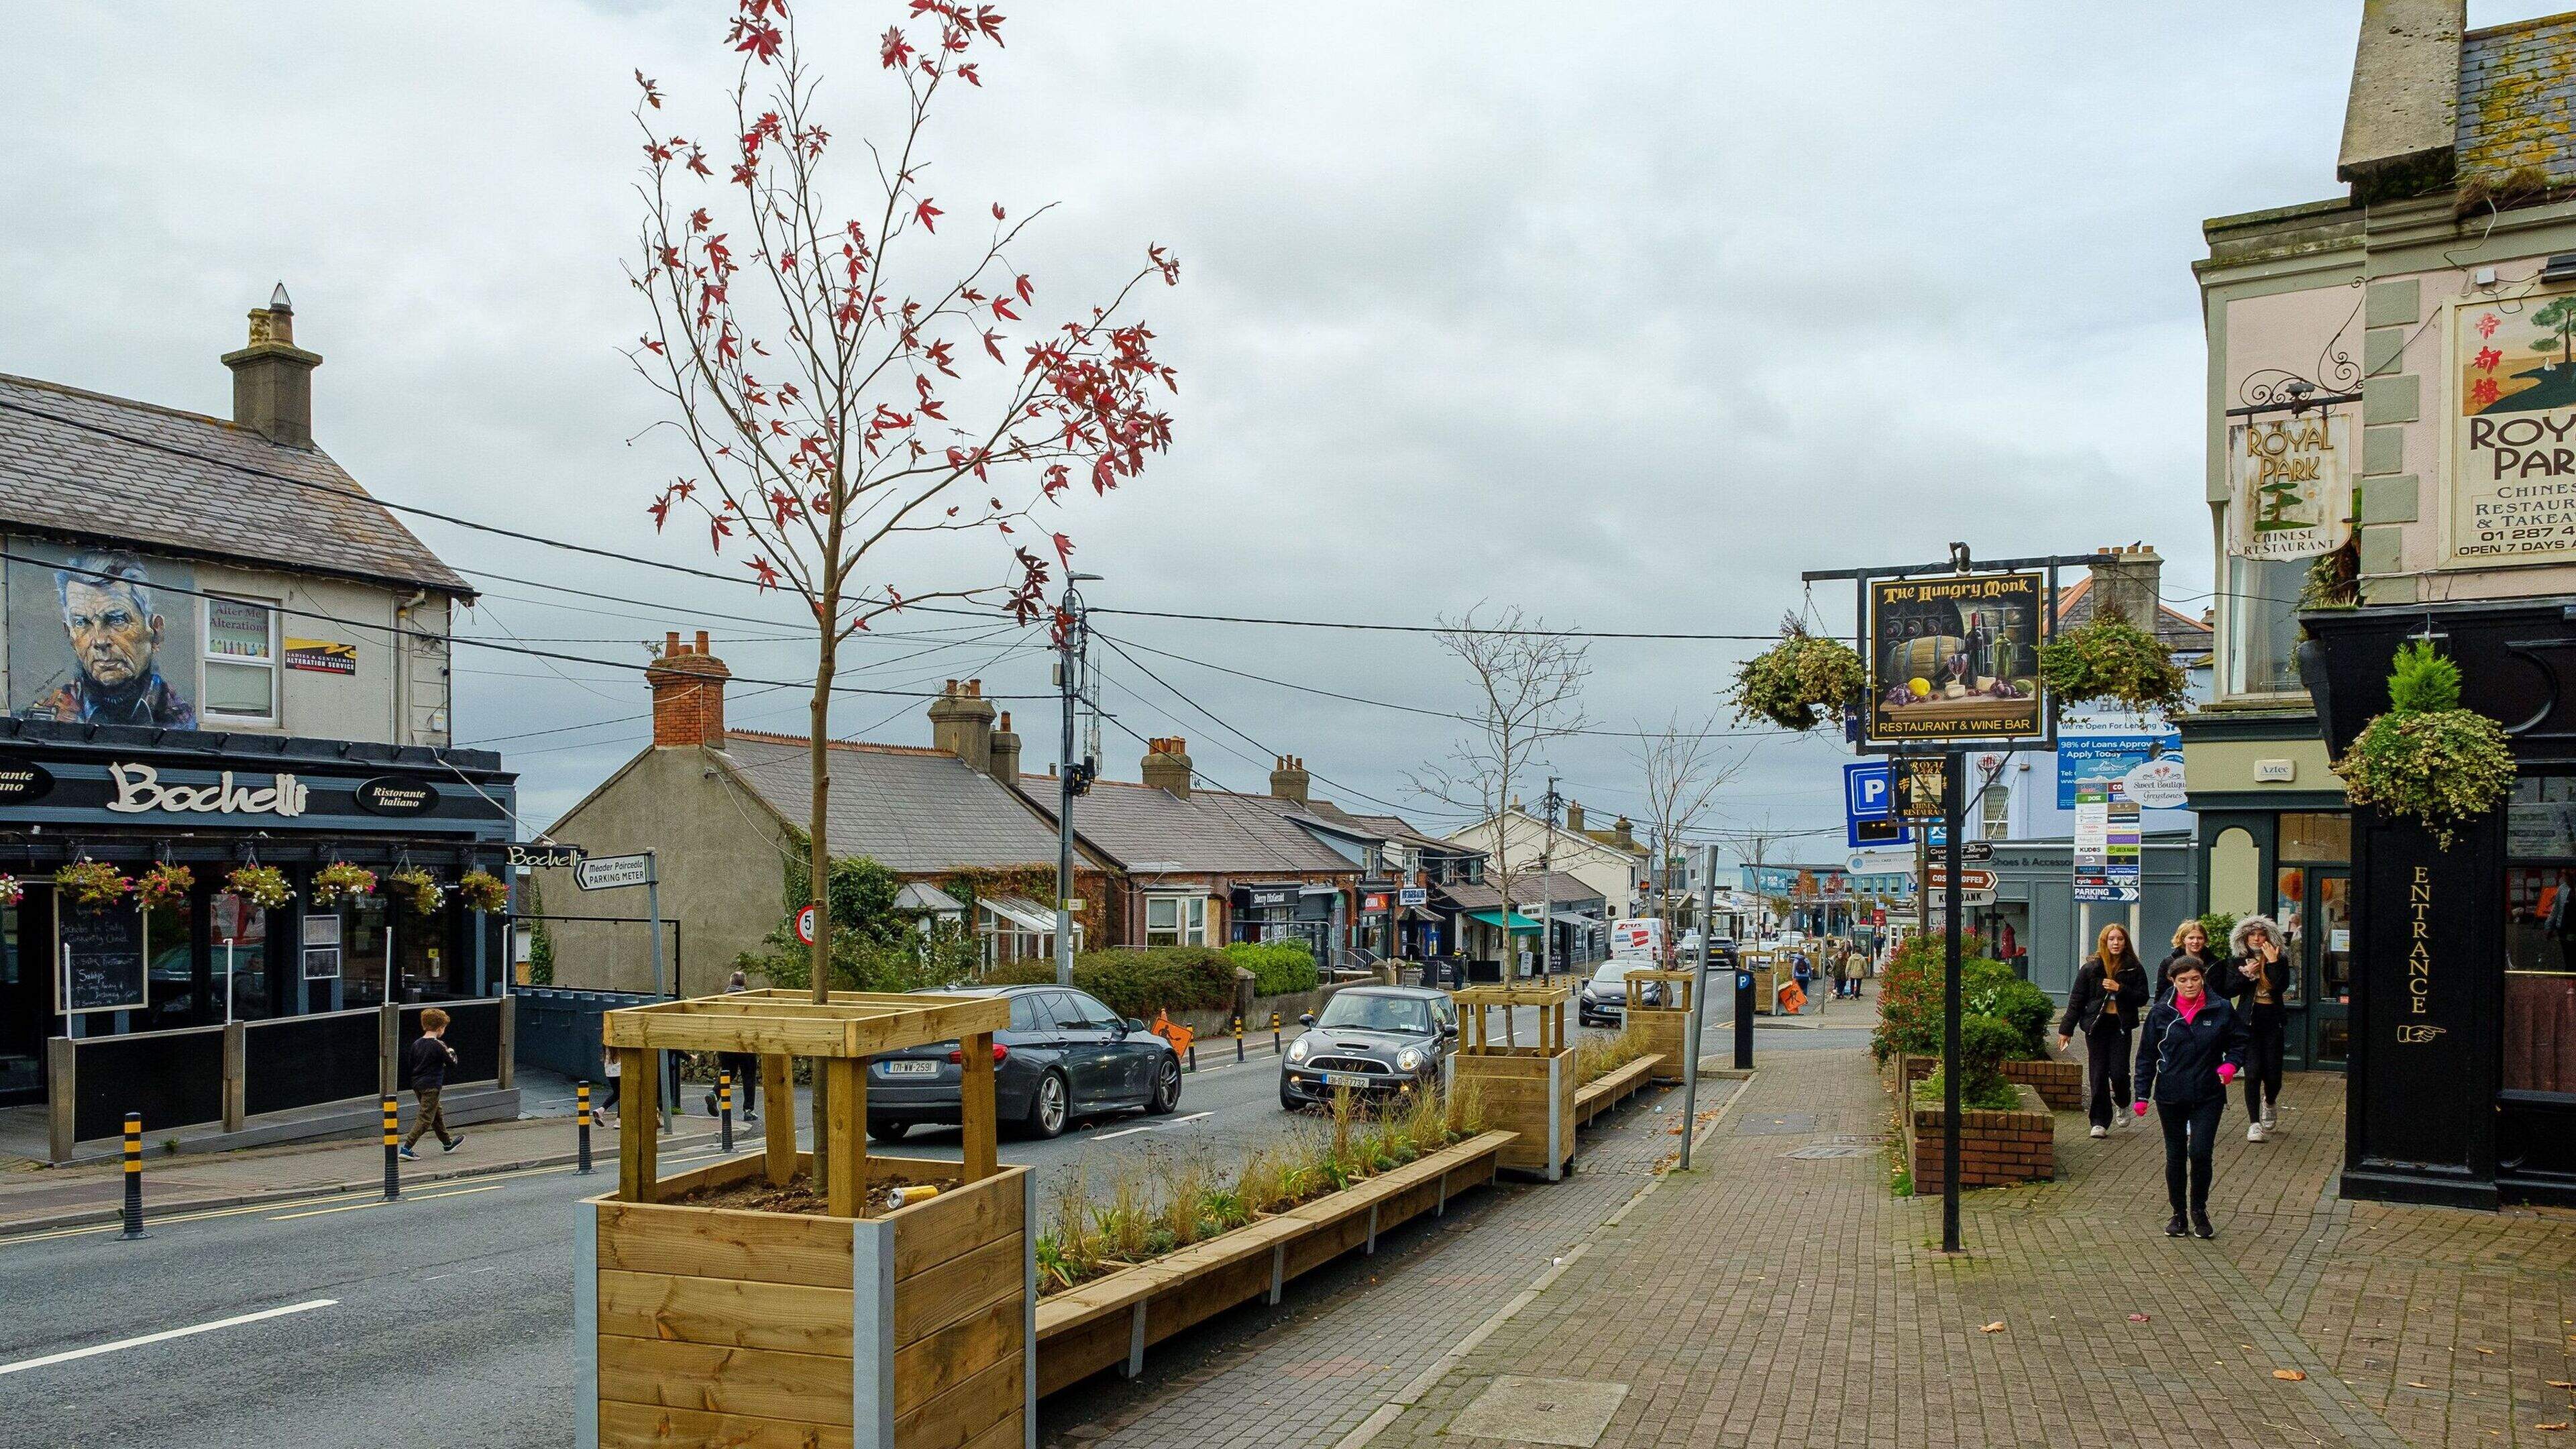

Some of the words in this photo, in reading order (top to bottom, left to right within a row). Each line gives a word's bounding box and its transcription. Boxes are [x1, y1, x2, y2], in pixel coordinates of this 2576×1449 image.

[2471, 414, 2576, 450] ROY
[2247, 427, 2334, 457] ROYAL
[2260, 455, 2320, 484] PARK
[2477, 519, 2492, 529] &
[2501, 513, 2576, 527] TAKEA
[2253, 529, 2315, 543] CHINESE
[2481, 531, 2504, 541] 01
[2512, 527, 2554, 539] 287
[2244, 539, 2334, 555] RESTAURANT
[2459, 545, 2501, 555] OPEN
[2506, 544, 2516, 552] 7
[2522, 540, 2565, 551] DAYS
[1917, 584, 1980, 602] Hungry
[1982, 578, 2033, 599] Monk
[286, 658, 326, 667] ALTERATION
[328, 661, 354, 670] SERVICE
[1879, 721, 1958, 733] RESTAURANT
[1960, 720, 1968, 730] &
[1970, 720, 2004, 731] WINE
[2004, 719, 2031, 730] BAR
[2086, 722, 2106, 731] Open
[2067, 751, 2092, 759] Apply
[0, 771, 34, 781] ante
[2261, 765, 2288, 773] Aztec
[107, 761, 310, 817] Bochelli
[372, 787, 426, 798] Ristorante
[1865, 780, 1885, 803] P
[378, 797, 420, 807] Italiano
[2143, 791, 2182, 802] Greystones
[1992, 857, 2019, 867] Shoes
[2022, 857, 2029, 866] &
[590, 873, 621, 884] PARKING
[622, 871, 644, 881] METER
[2408, 867, 2431, 1014] ENTRANCE
